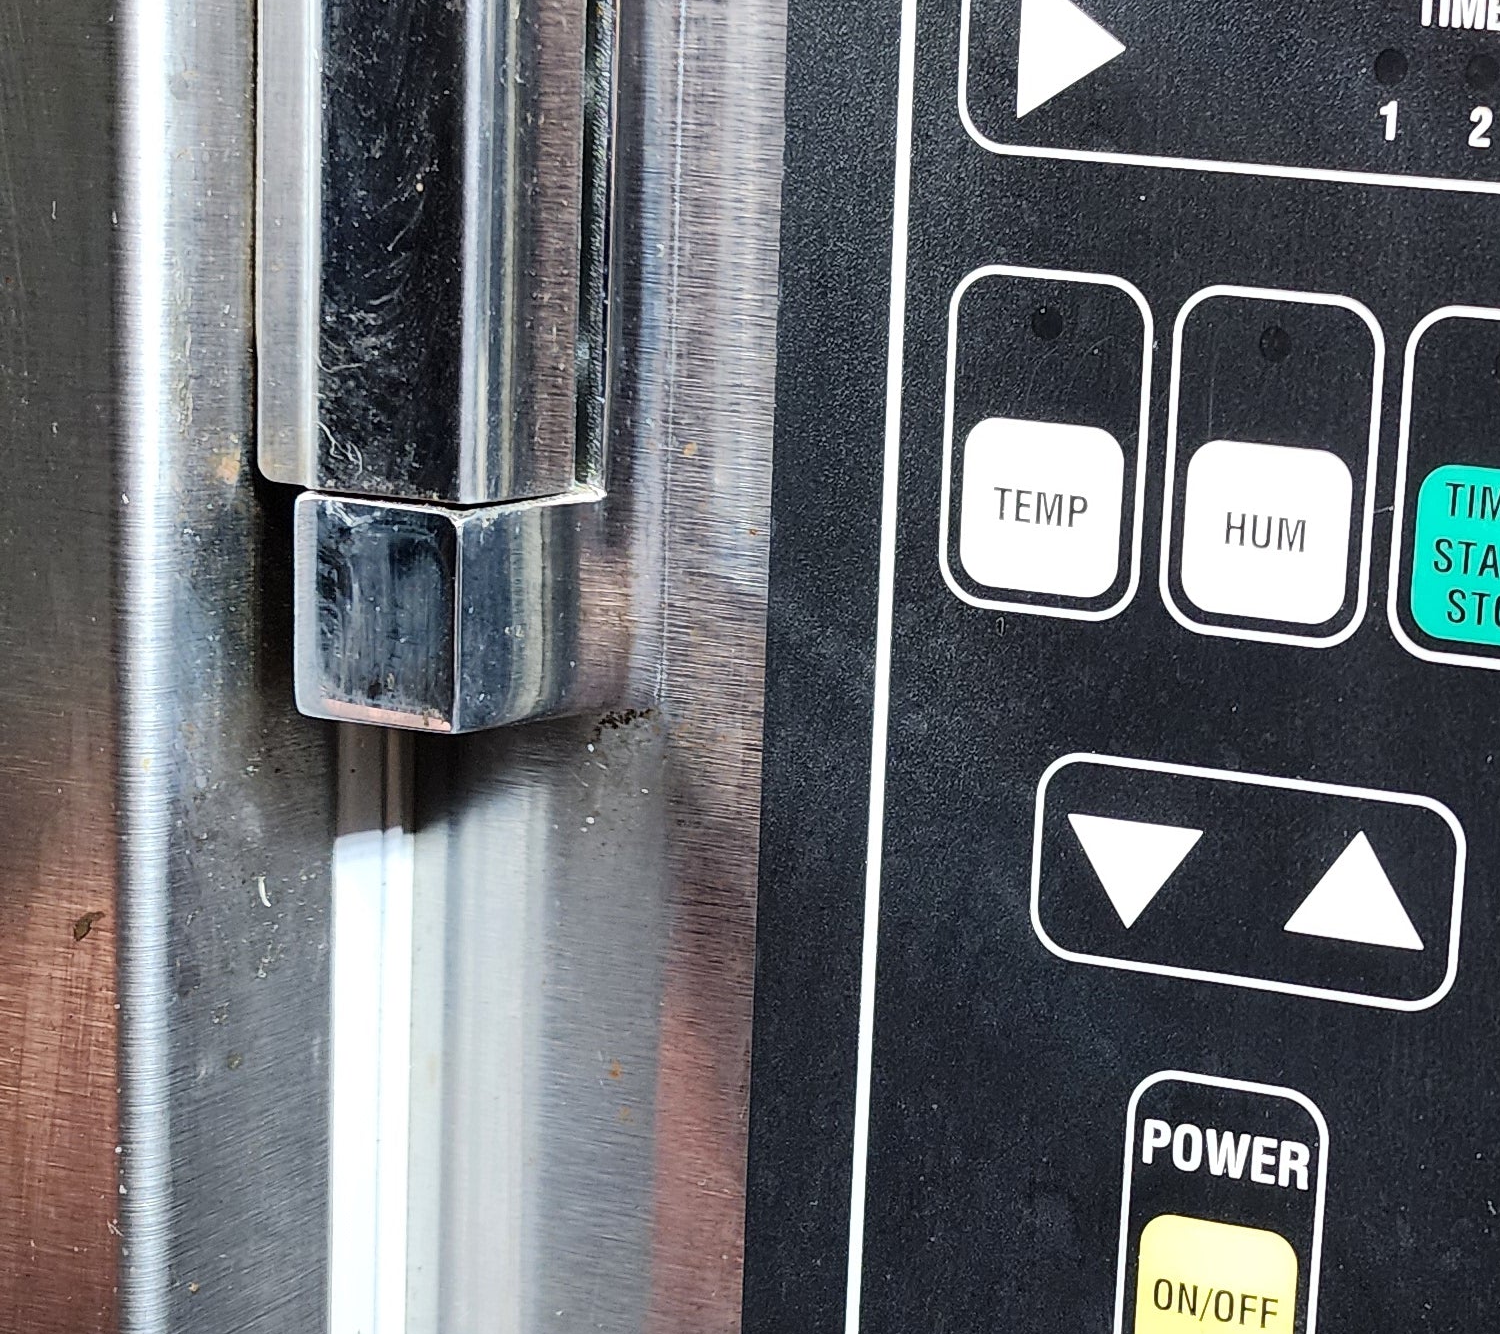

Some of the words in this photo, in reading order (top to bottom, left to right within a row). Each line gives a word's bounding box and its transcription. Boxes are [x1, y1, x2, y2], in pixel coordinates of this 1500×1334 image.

[1379, 100, 1398, 141] 1
[1468, 105, 1493, 148] 2
[993, 486, 1088, 528] TEMP
[1224, 511, 1307, 553] HUM
[1141, 1118, 1310, 1191] POWER
[1153, 1278, 1279, 1329] ON/OFF
